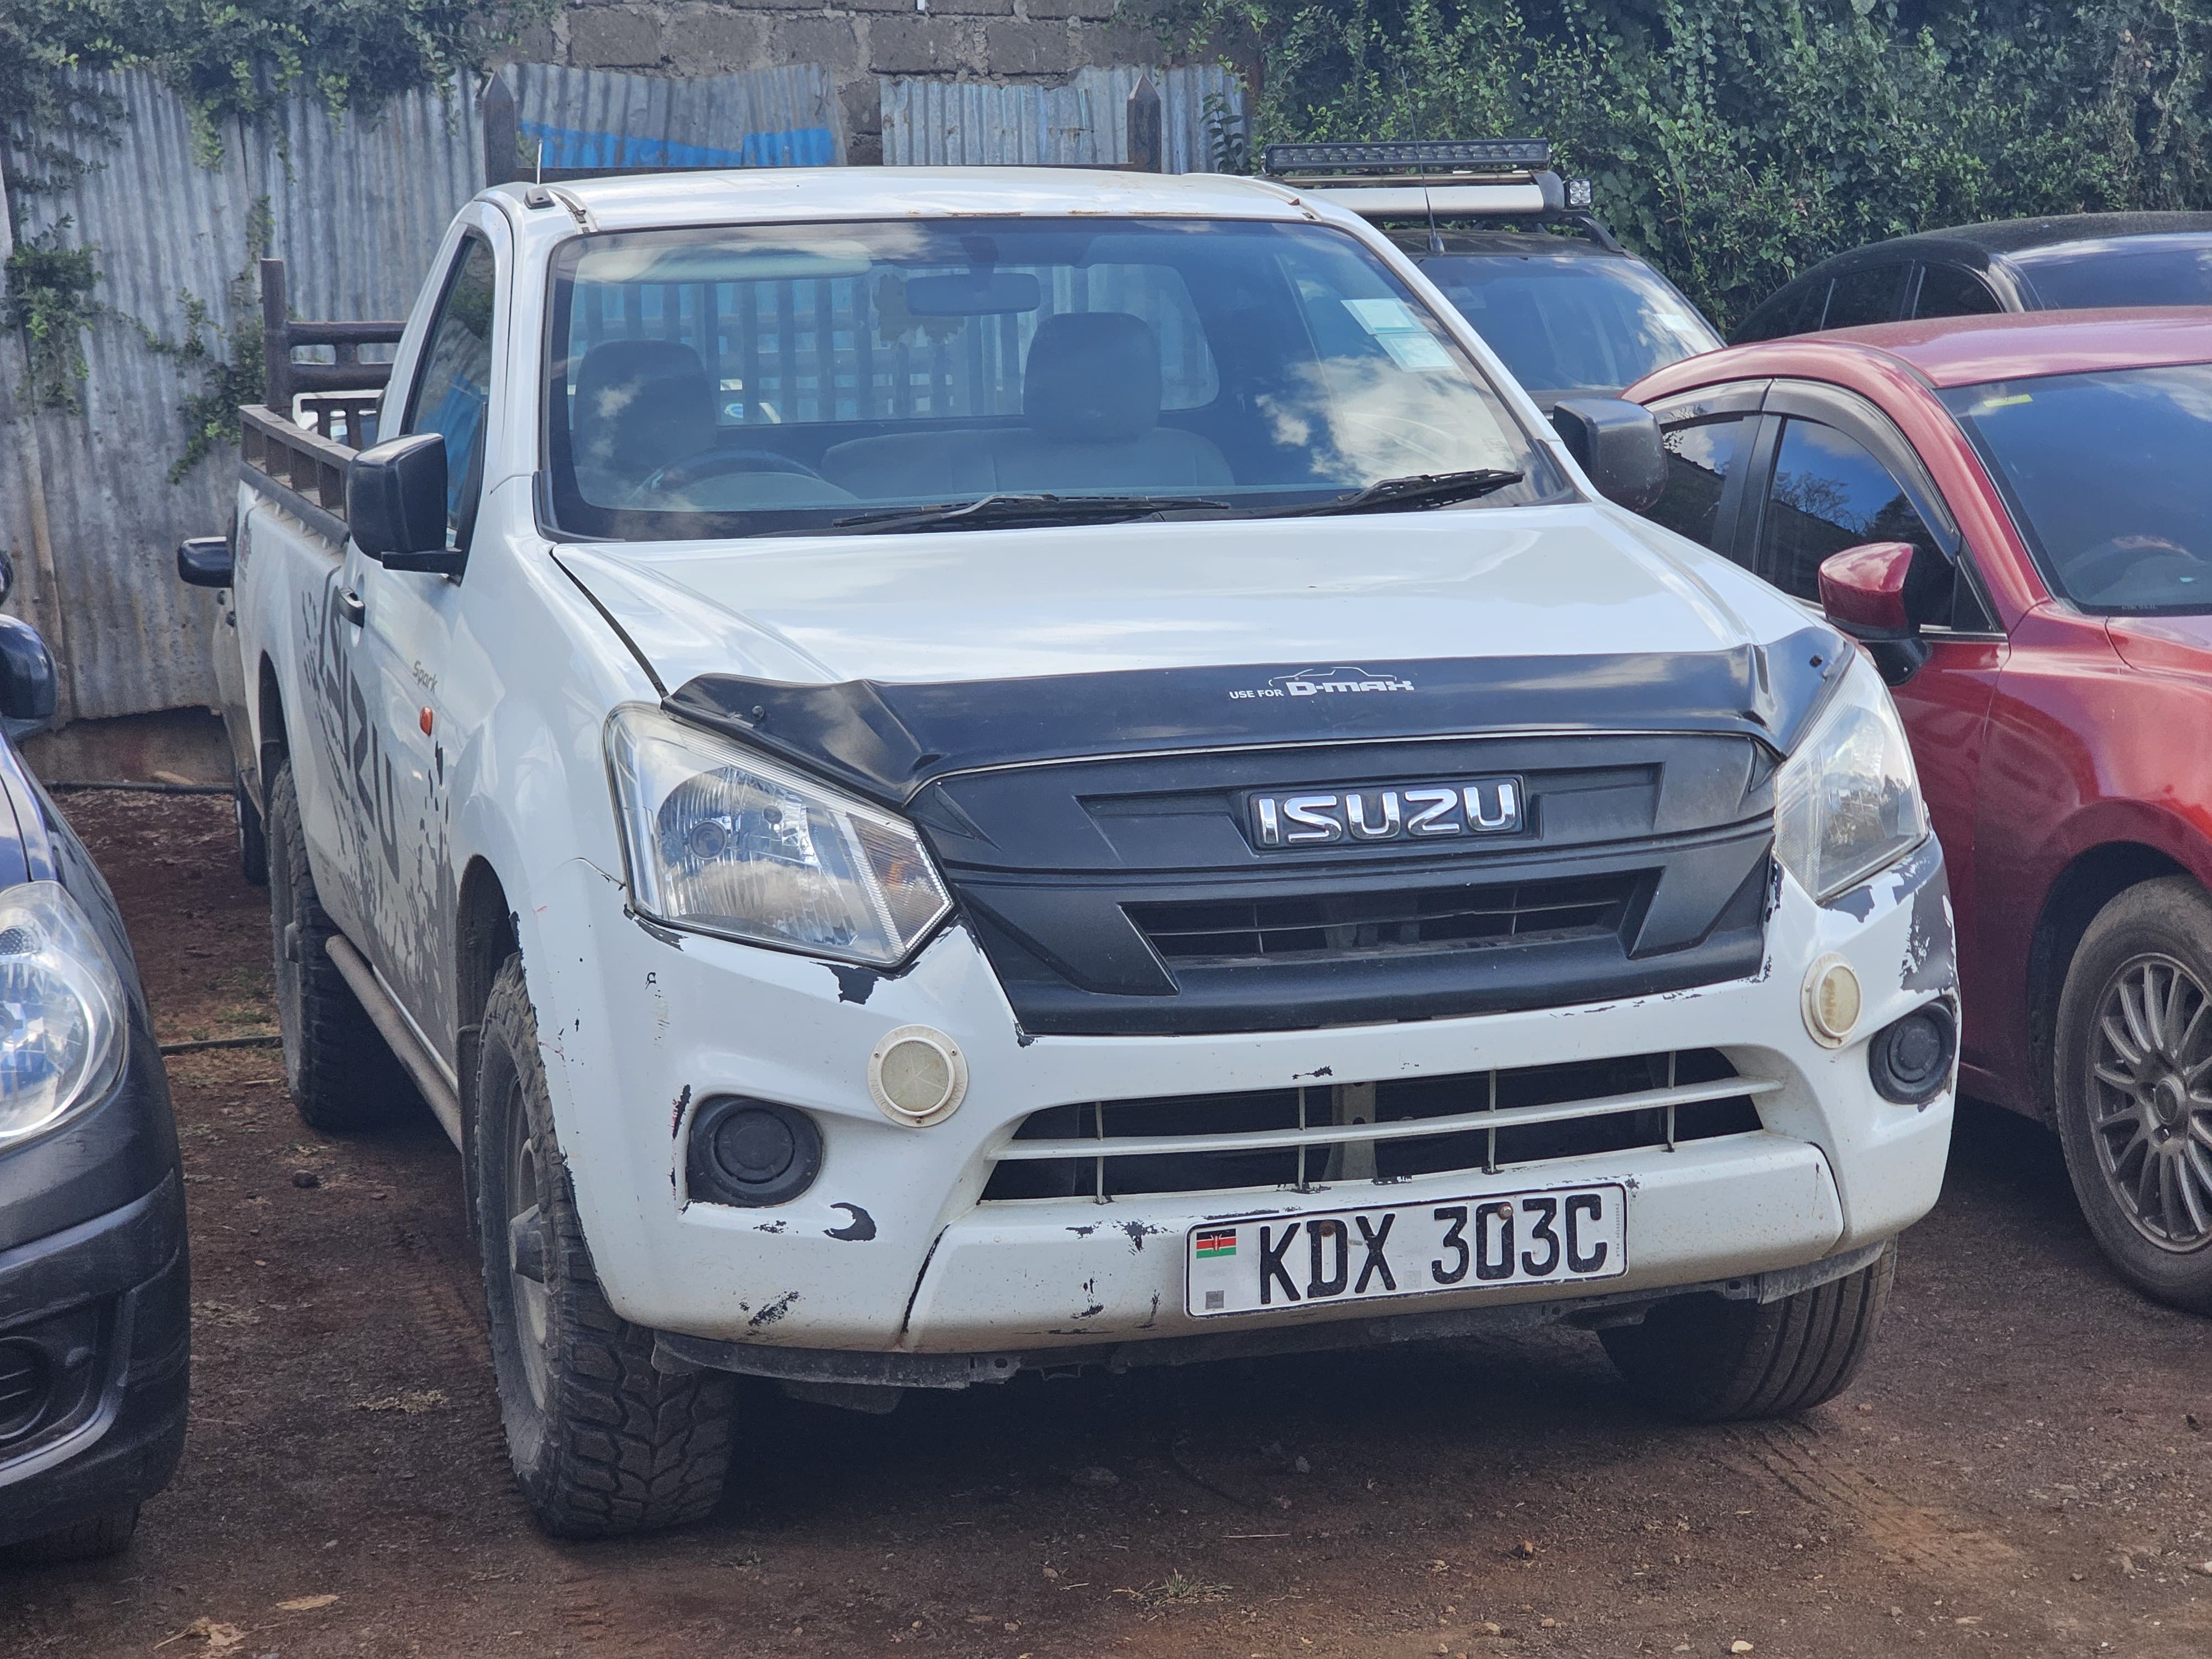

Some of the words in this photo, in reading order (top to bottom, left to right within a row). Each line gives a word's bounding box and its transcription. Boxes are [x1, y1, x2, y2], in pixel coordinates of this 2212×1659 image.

[413, 660, 437, 694] Spark
[1229, 690, 1255, 699] USE
[1257, 688, 1284, 698] FOR
[1285, 681, 1415, 696] D-MAX
[1258, 783, 1516, 844] ISUZU
[1260, 1213, 1396, 1305] KDX
[1431, 1193, 1608, 1285] 303C
